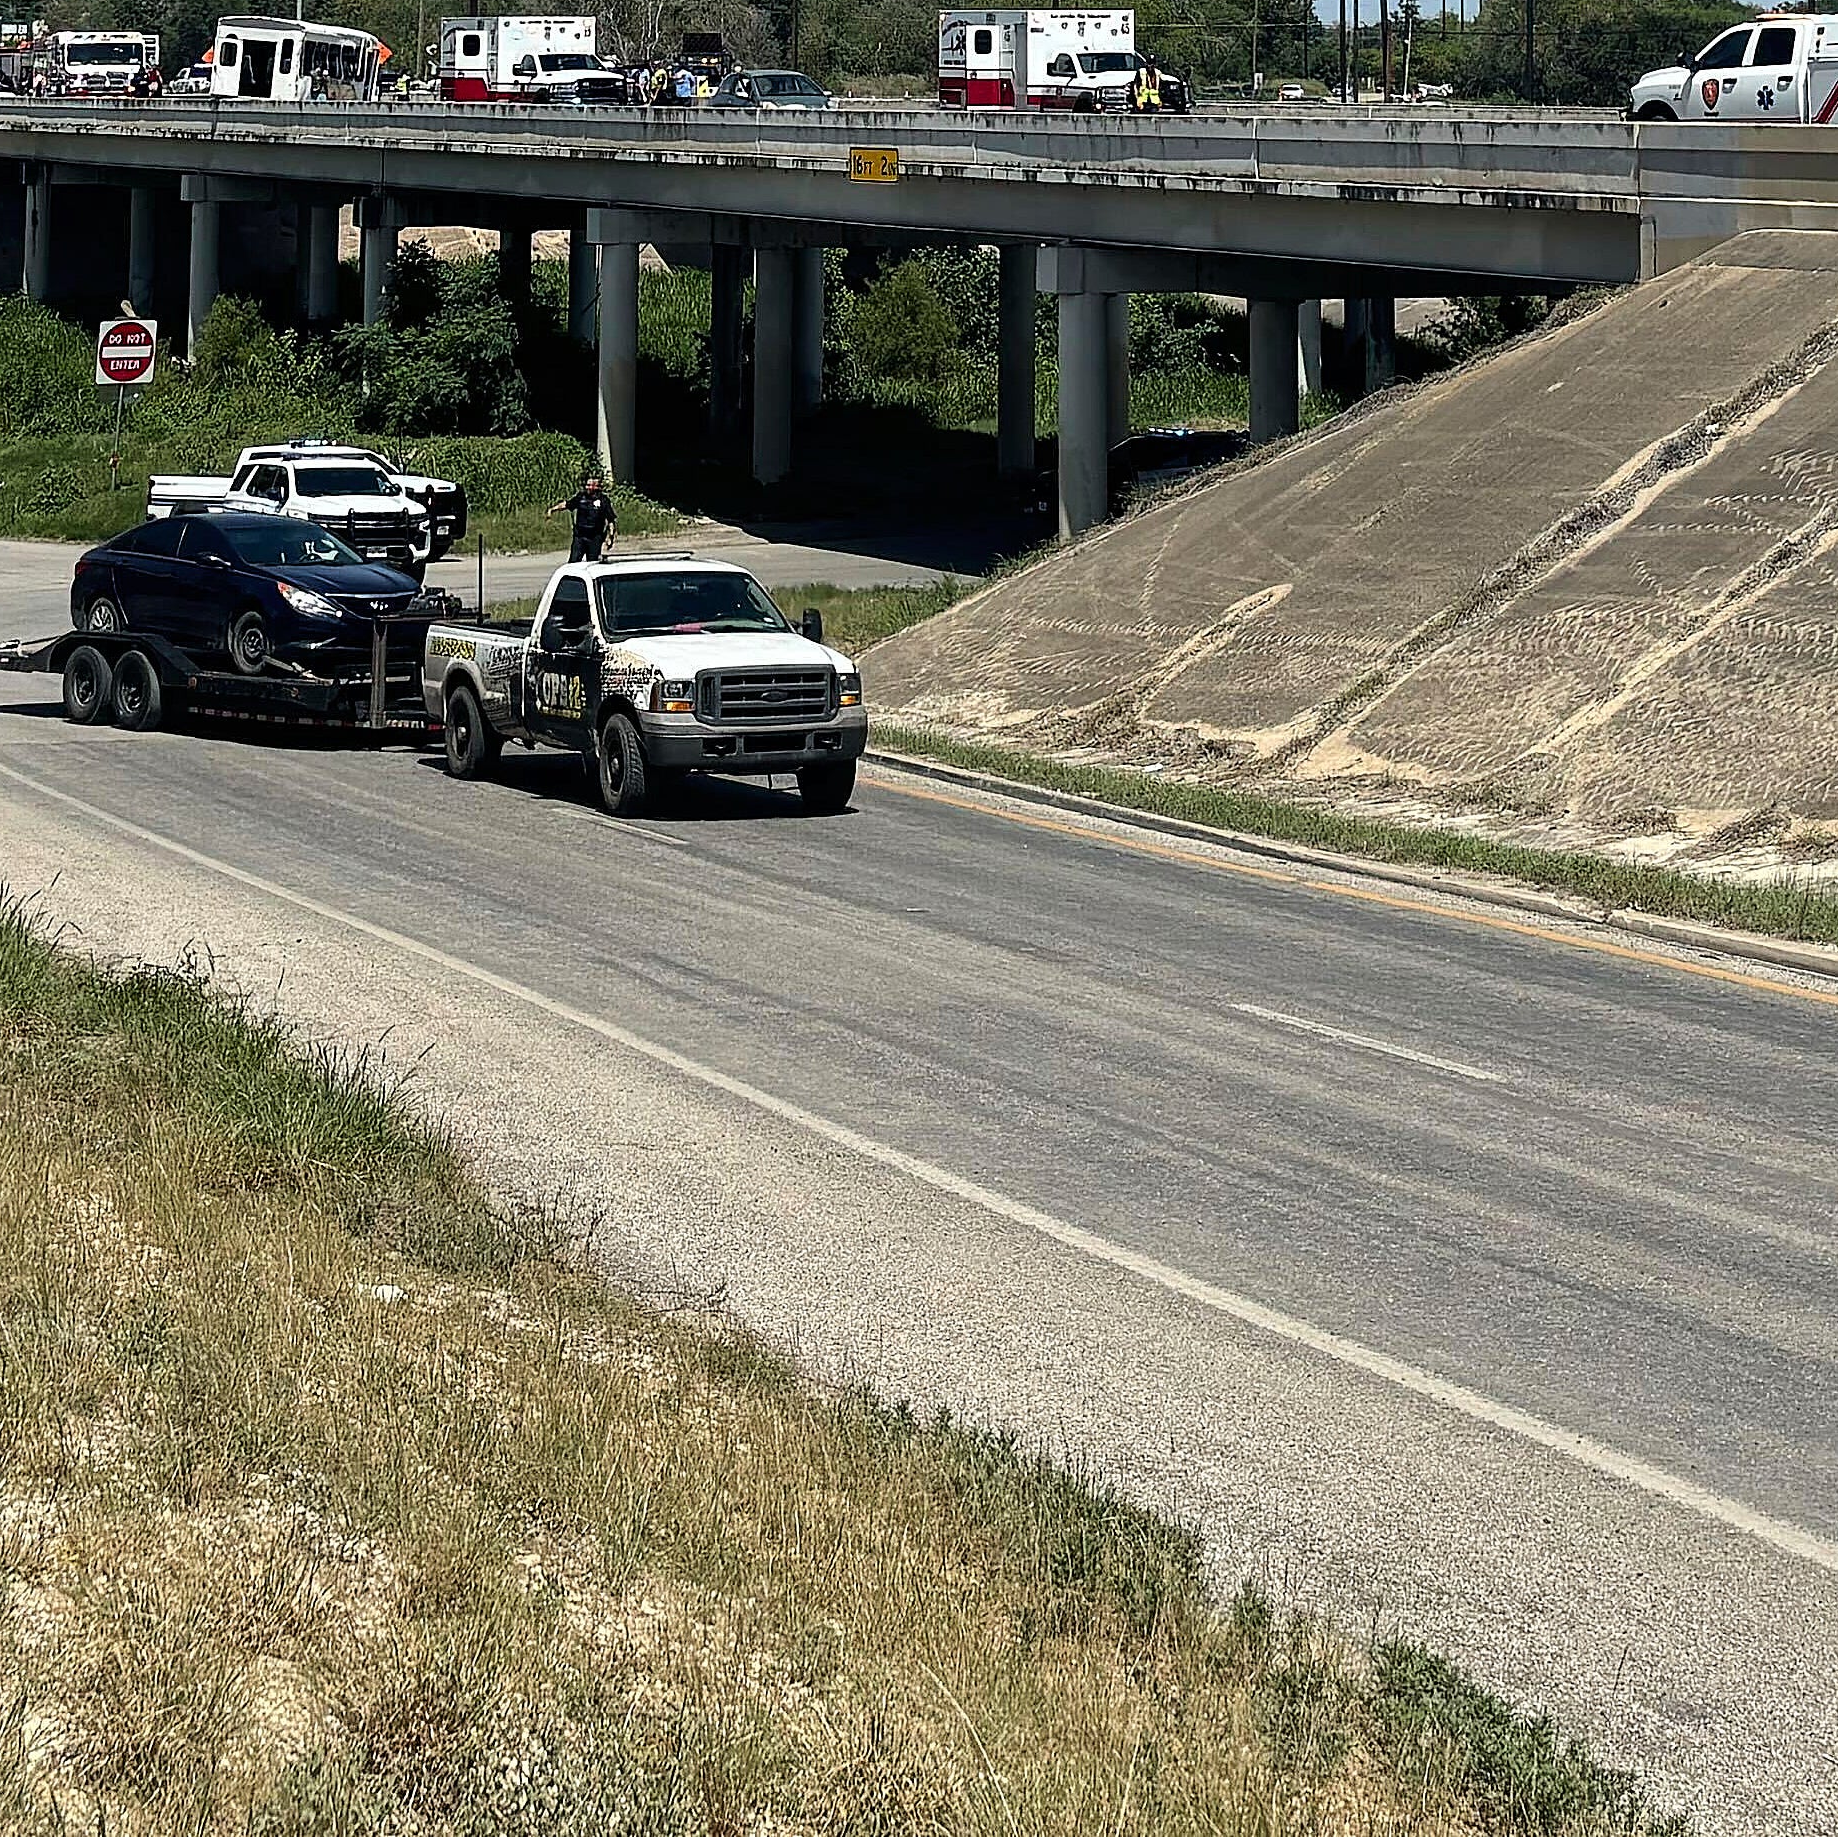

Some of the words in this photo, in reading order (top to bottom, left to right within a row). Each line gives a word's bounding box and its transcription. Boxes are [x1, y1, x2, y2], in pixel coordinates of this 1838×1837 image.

[109, 334, 122, 344] DO
[127, 333, 146, 344] NOT
[110, 360, 140, 370] ENTER
